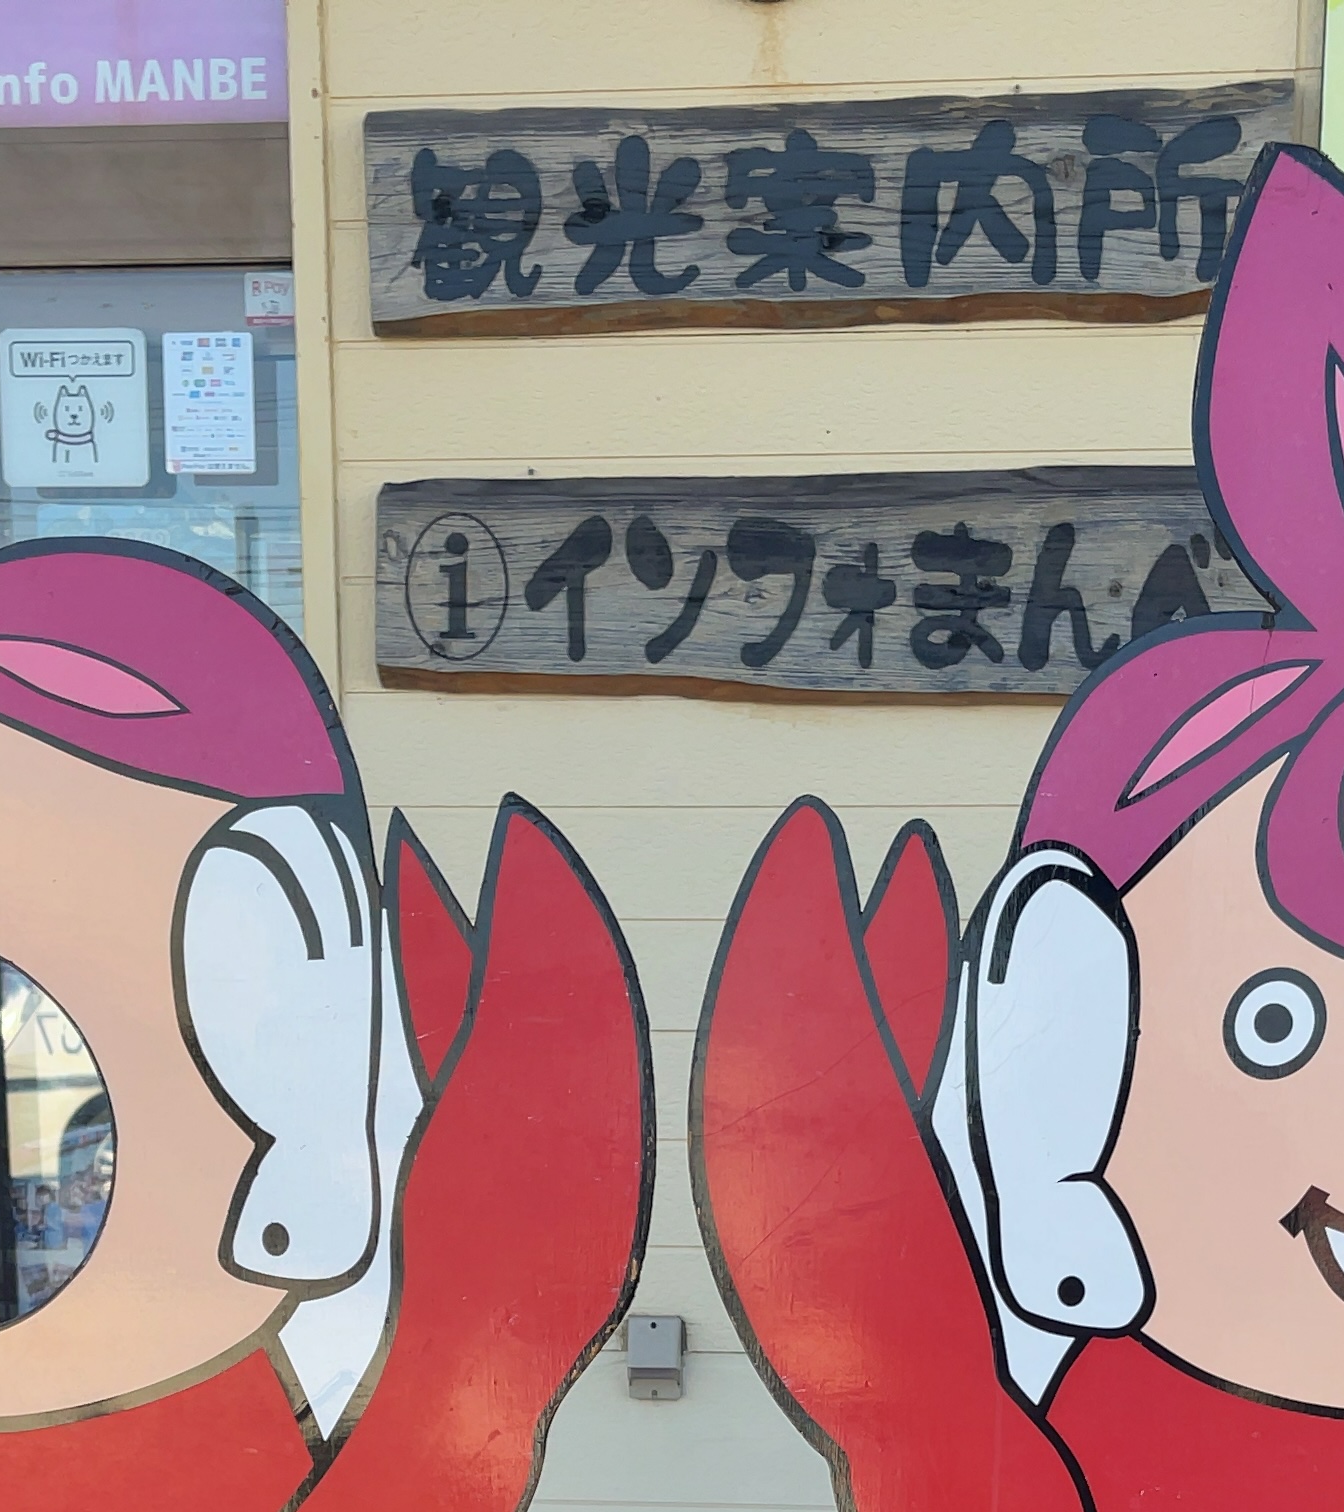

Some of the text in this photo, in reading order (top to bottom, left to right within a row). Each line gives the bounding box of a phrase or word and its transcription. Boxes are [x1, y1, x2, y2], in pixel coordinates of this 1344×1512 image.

[94, 57, 268, 104] MANBE
[411, 112, 1246, 302] 観光案内所
